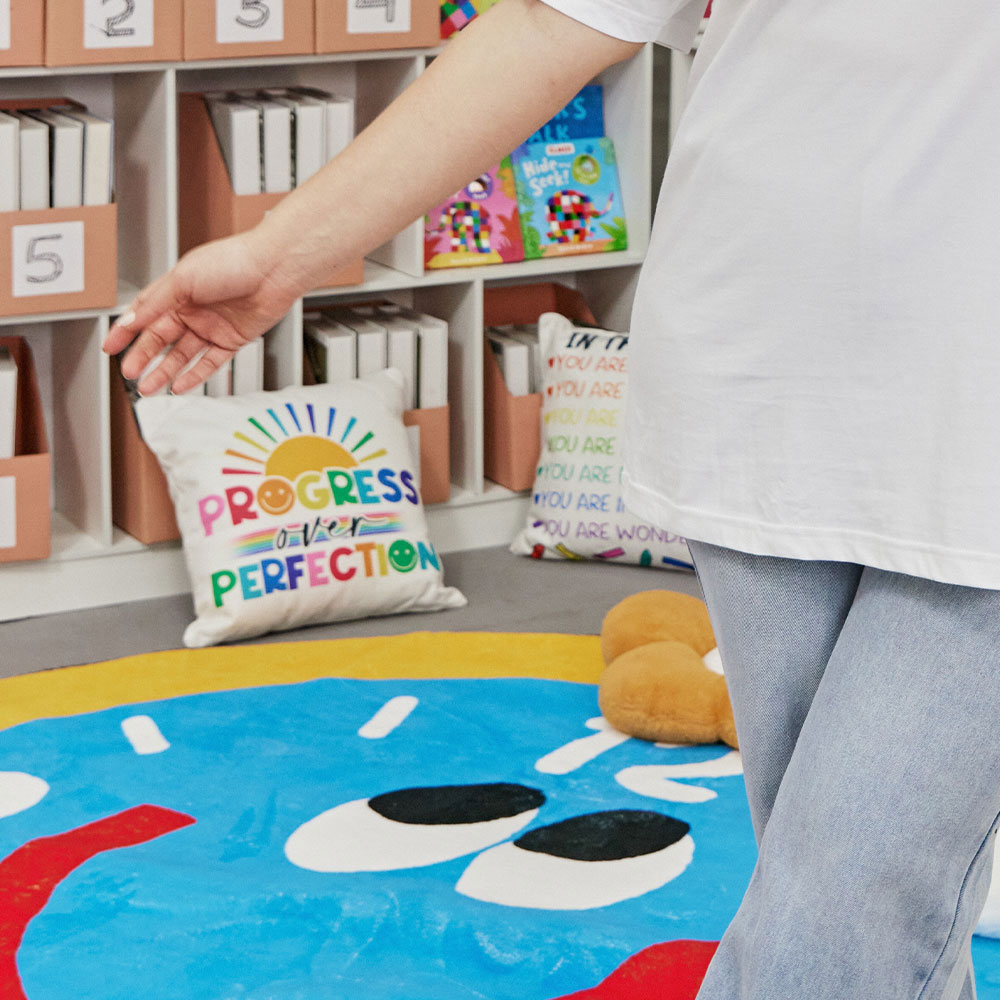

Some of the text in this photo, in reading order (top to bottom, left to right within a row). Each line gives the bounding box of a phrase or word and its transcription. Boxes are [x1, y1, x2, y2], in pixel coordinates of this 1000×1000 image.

[26, 234, 64, 284] 5
[565, 332, 597, 350] IN
[596, 356, 628, 374] ARE
[590, 382, 625, 399] ARE
[583, 436, 617, 455] ARE
[579, 465, 613, 484] ARE
[198, 468, 419, 537] PROGRESS
[577, 494, 612, 512] ARE
[276, 513, 387, 549] over
[576, 522, 610, 540] ARE
[211, 539, 441, 608] PERFECTION
